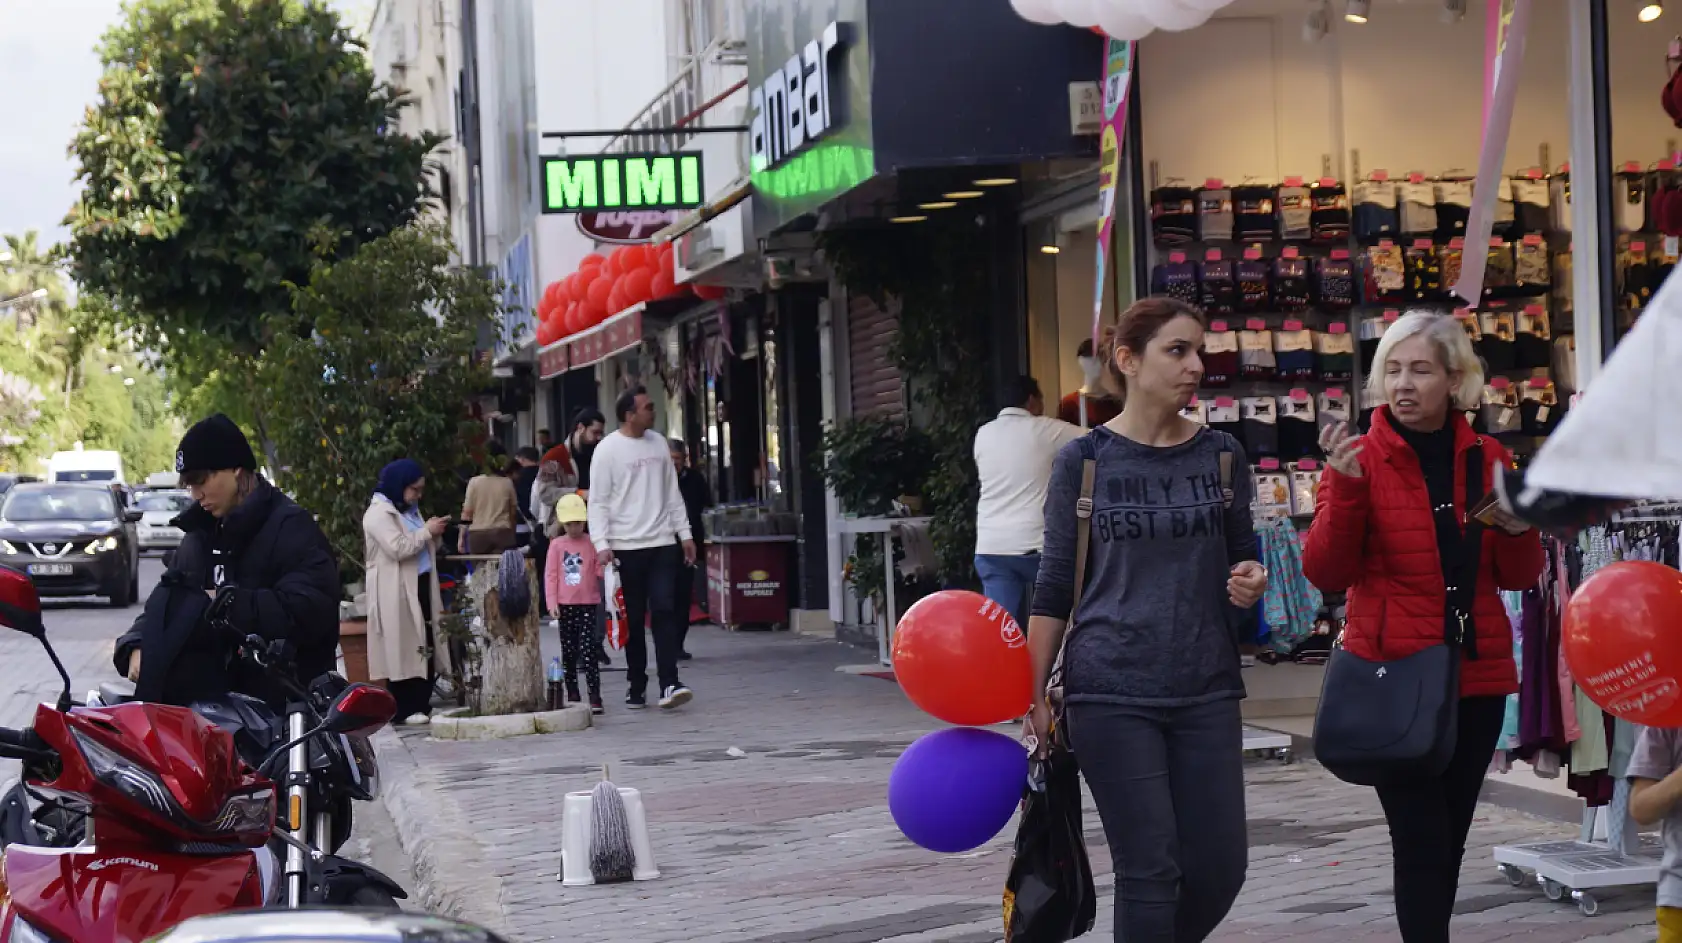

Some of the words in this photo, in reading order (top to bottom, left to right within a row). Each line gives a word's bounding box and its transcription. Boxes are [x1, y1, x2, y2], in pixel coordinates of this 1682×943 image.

[546, 156, 700, 208] MIMI
[1107, 476, 1173, 505] ONLY
[1186, 472, 1224, 501] TH
[1098, 510, 1158, 543] BEST
